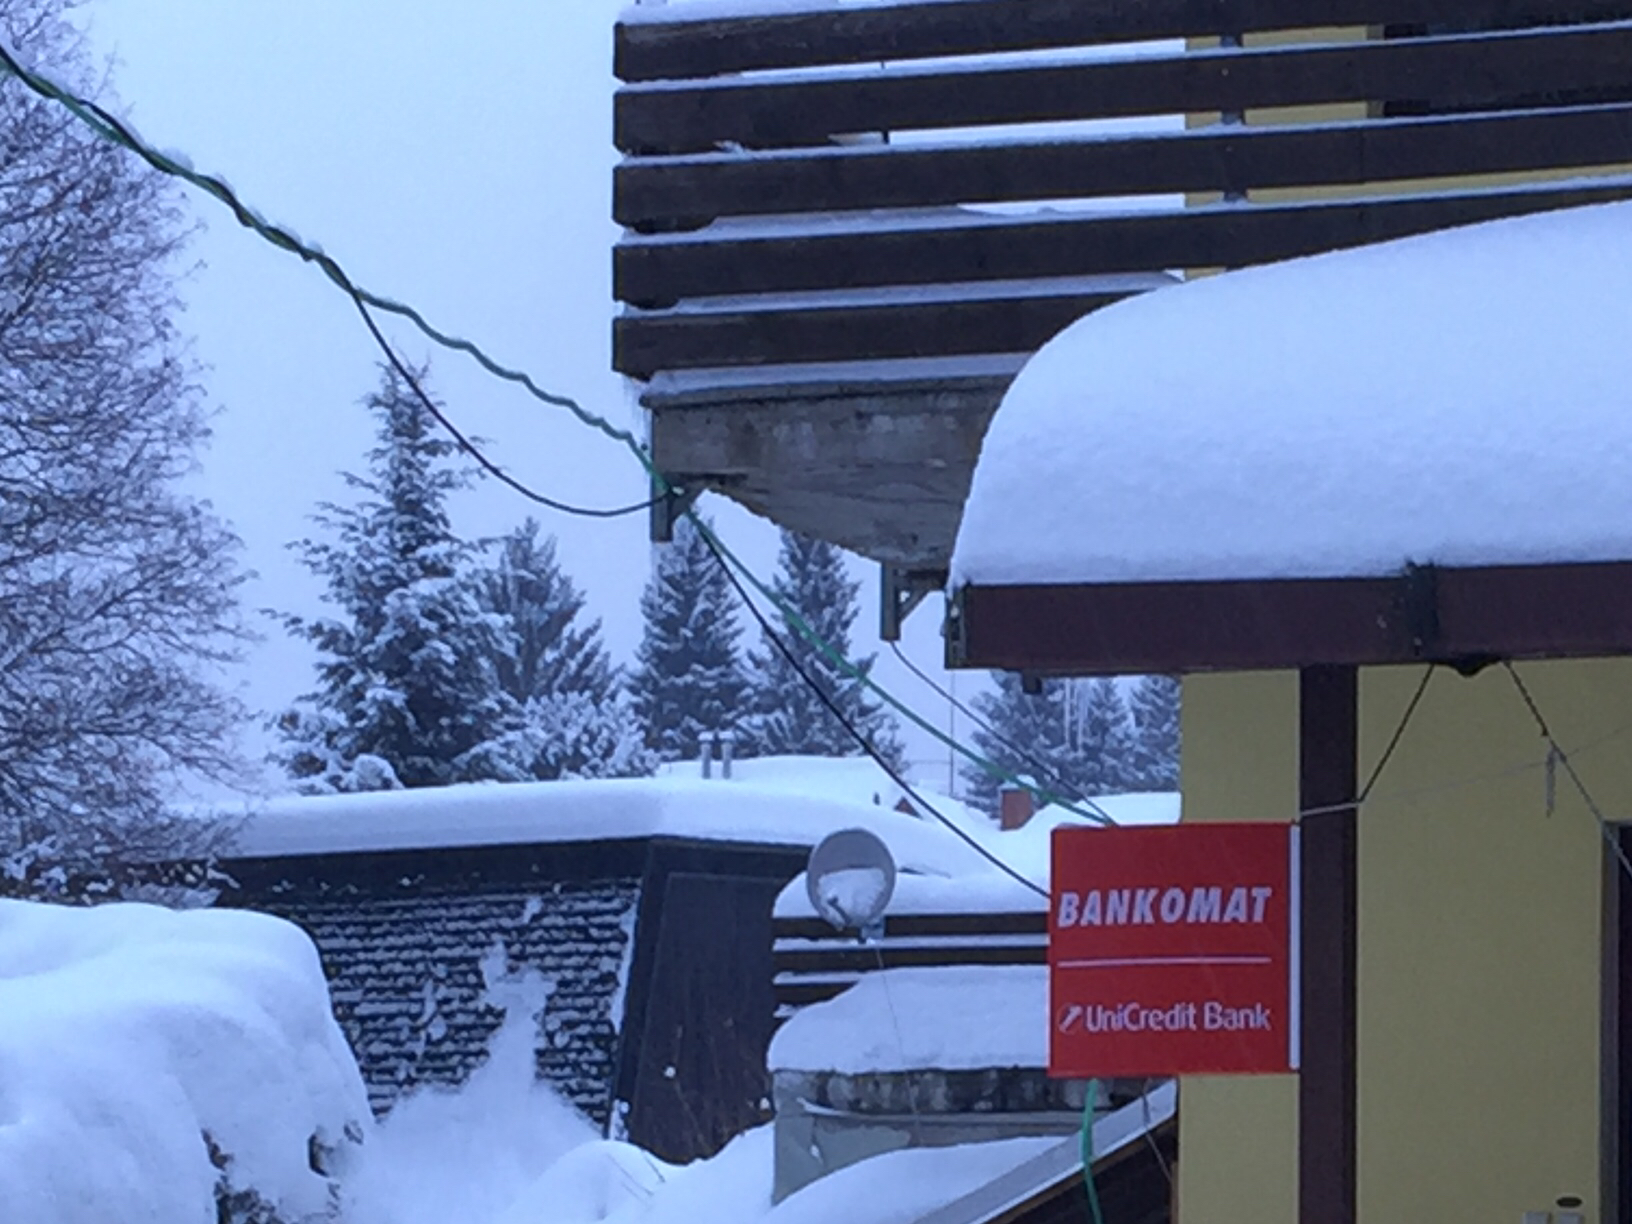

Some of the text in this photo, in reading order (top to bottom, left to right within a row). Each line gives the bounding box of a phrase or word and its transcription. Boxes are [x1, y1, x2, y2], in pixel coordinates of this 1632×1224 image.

[1057, 886, 1273, 928] BANKOMAT
[1086, 1001, 1272, 1032] UniCredit Bank
